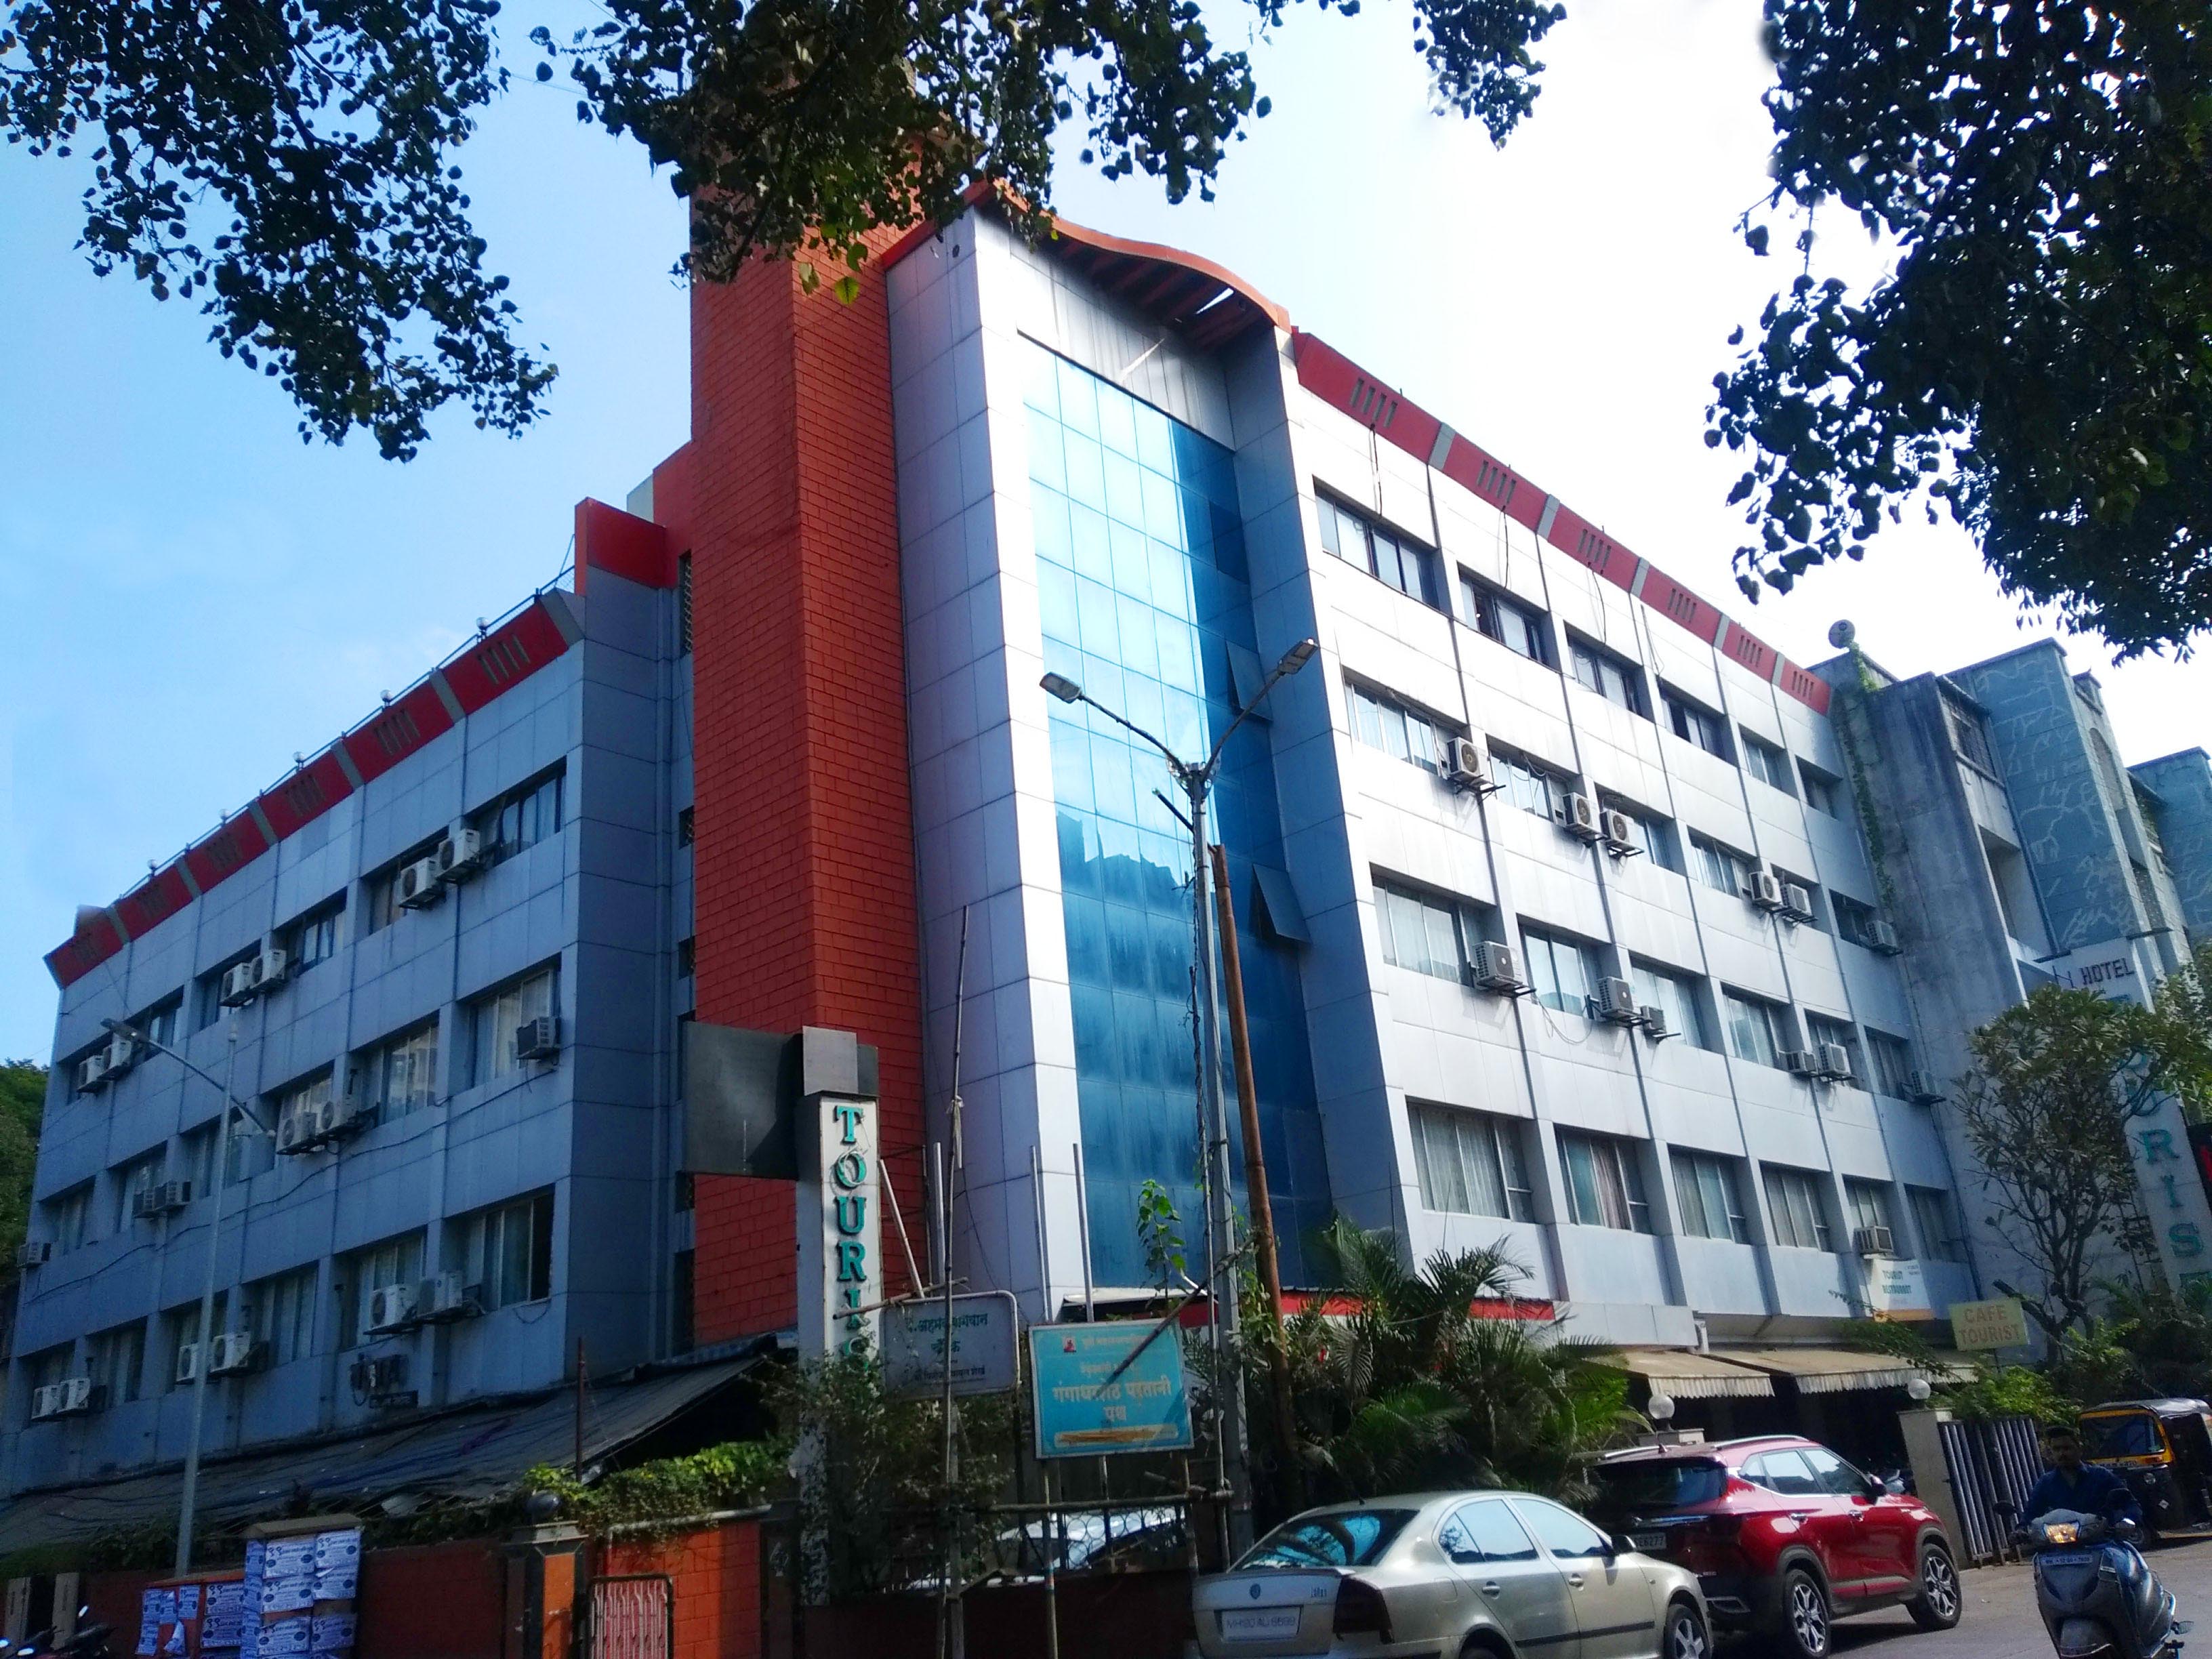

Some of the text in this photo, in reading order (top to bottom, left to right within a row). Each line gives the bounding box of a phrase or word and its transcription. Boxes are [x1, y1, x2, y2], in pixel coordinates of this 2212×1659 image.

[2079, 958, 2134, 985] HOTEL
[1965, 1305, 2007, 1323] CAFE
[1959, 1324, 2020, 1345] TOURIST
